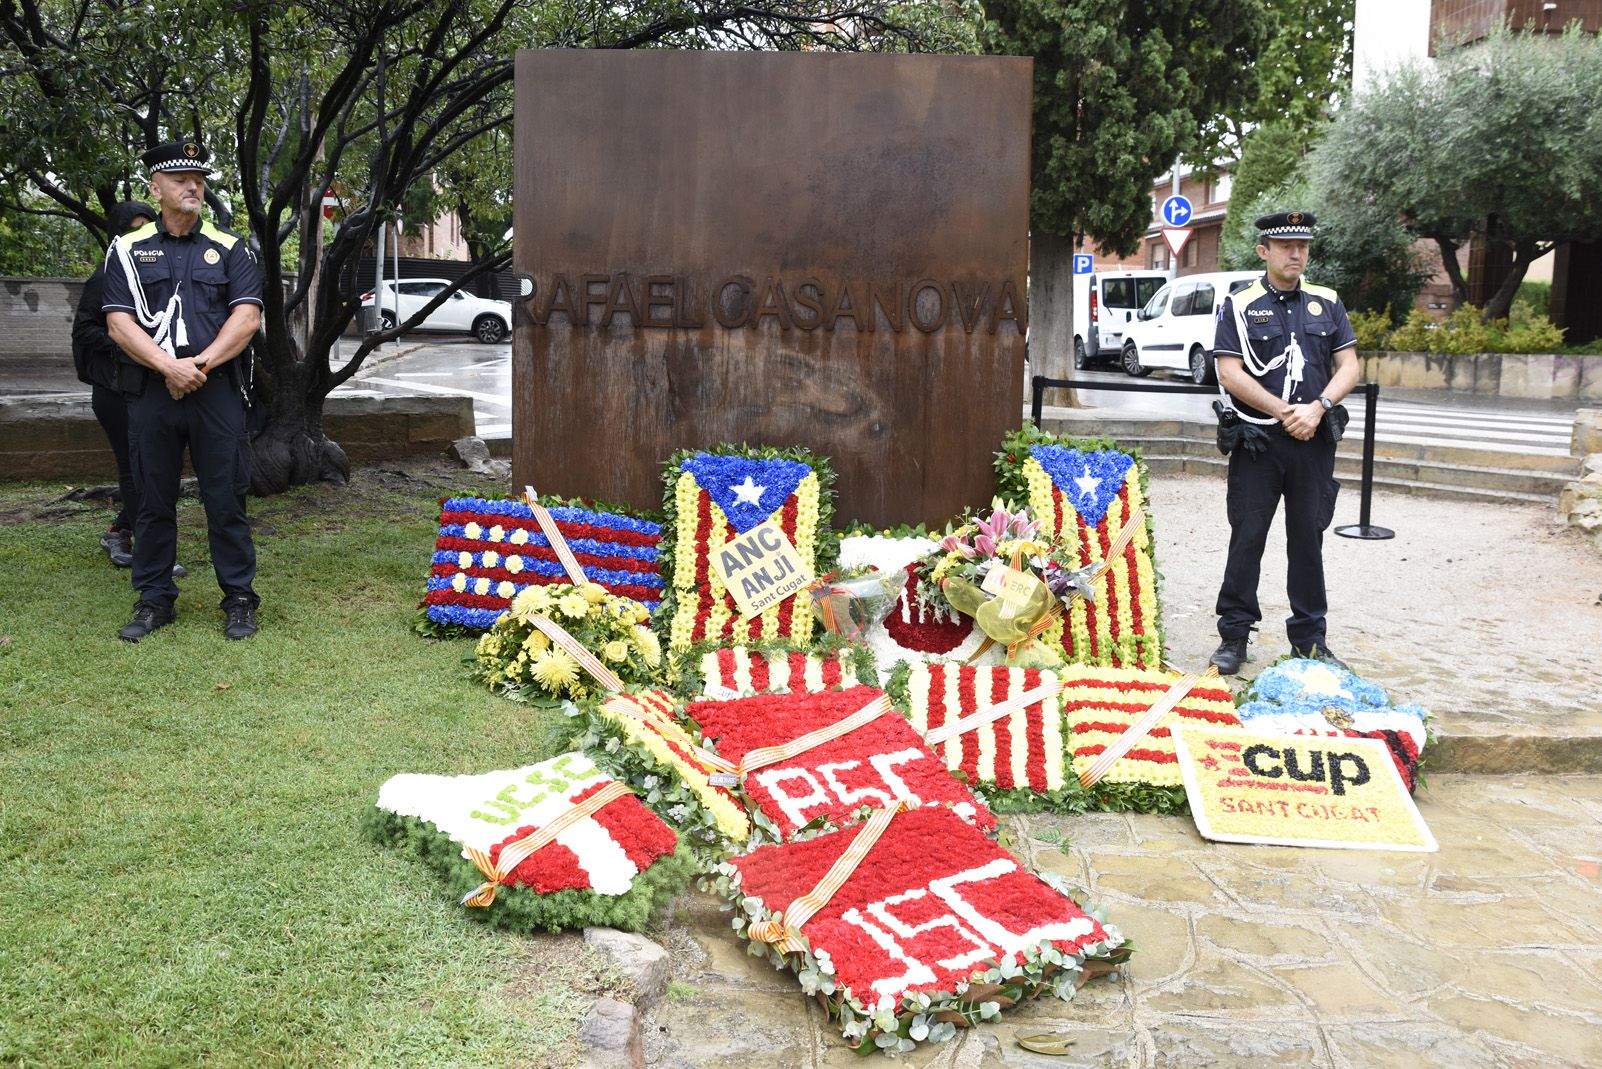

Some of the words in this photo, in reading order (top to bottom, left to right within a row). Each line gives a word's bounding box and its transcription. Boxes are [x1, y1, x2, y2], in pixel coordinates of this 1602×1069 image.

[1076, 255, 1090, 273] P
[511, 272, 704, 328] RAFAEL
[713, 274, 1027, 334] CASANOVA
[720, 527, 782, 579] ANC
[741, 554, 796, 600] ANJI
[751, 592, 777, 611] Sant
[776, 573, 808, 597] Cugat
[1242, 743, 1372, 796] cup
[1219, 797, 1290, 819] SANT
[1295, 803, 1382, 824] CUGAT
